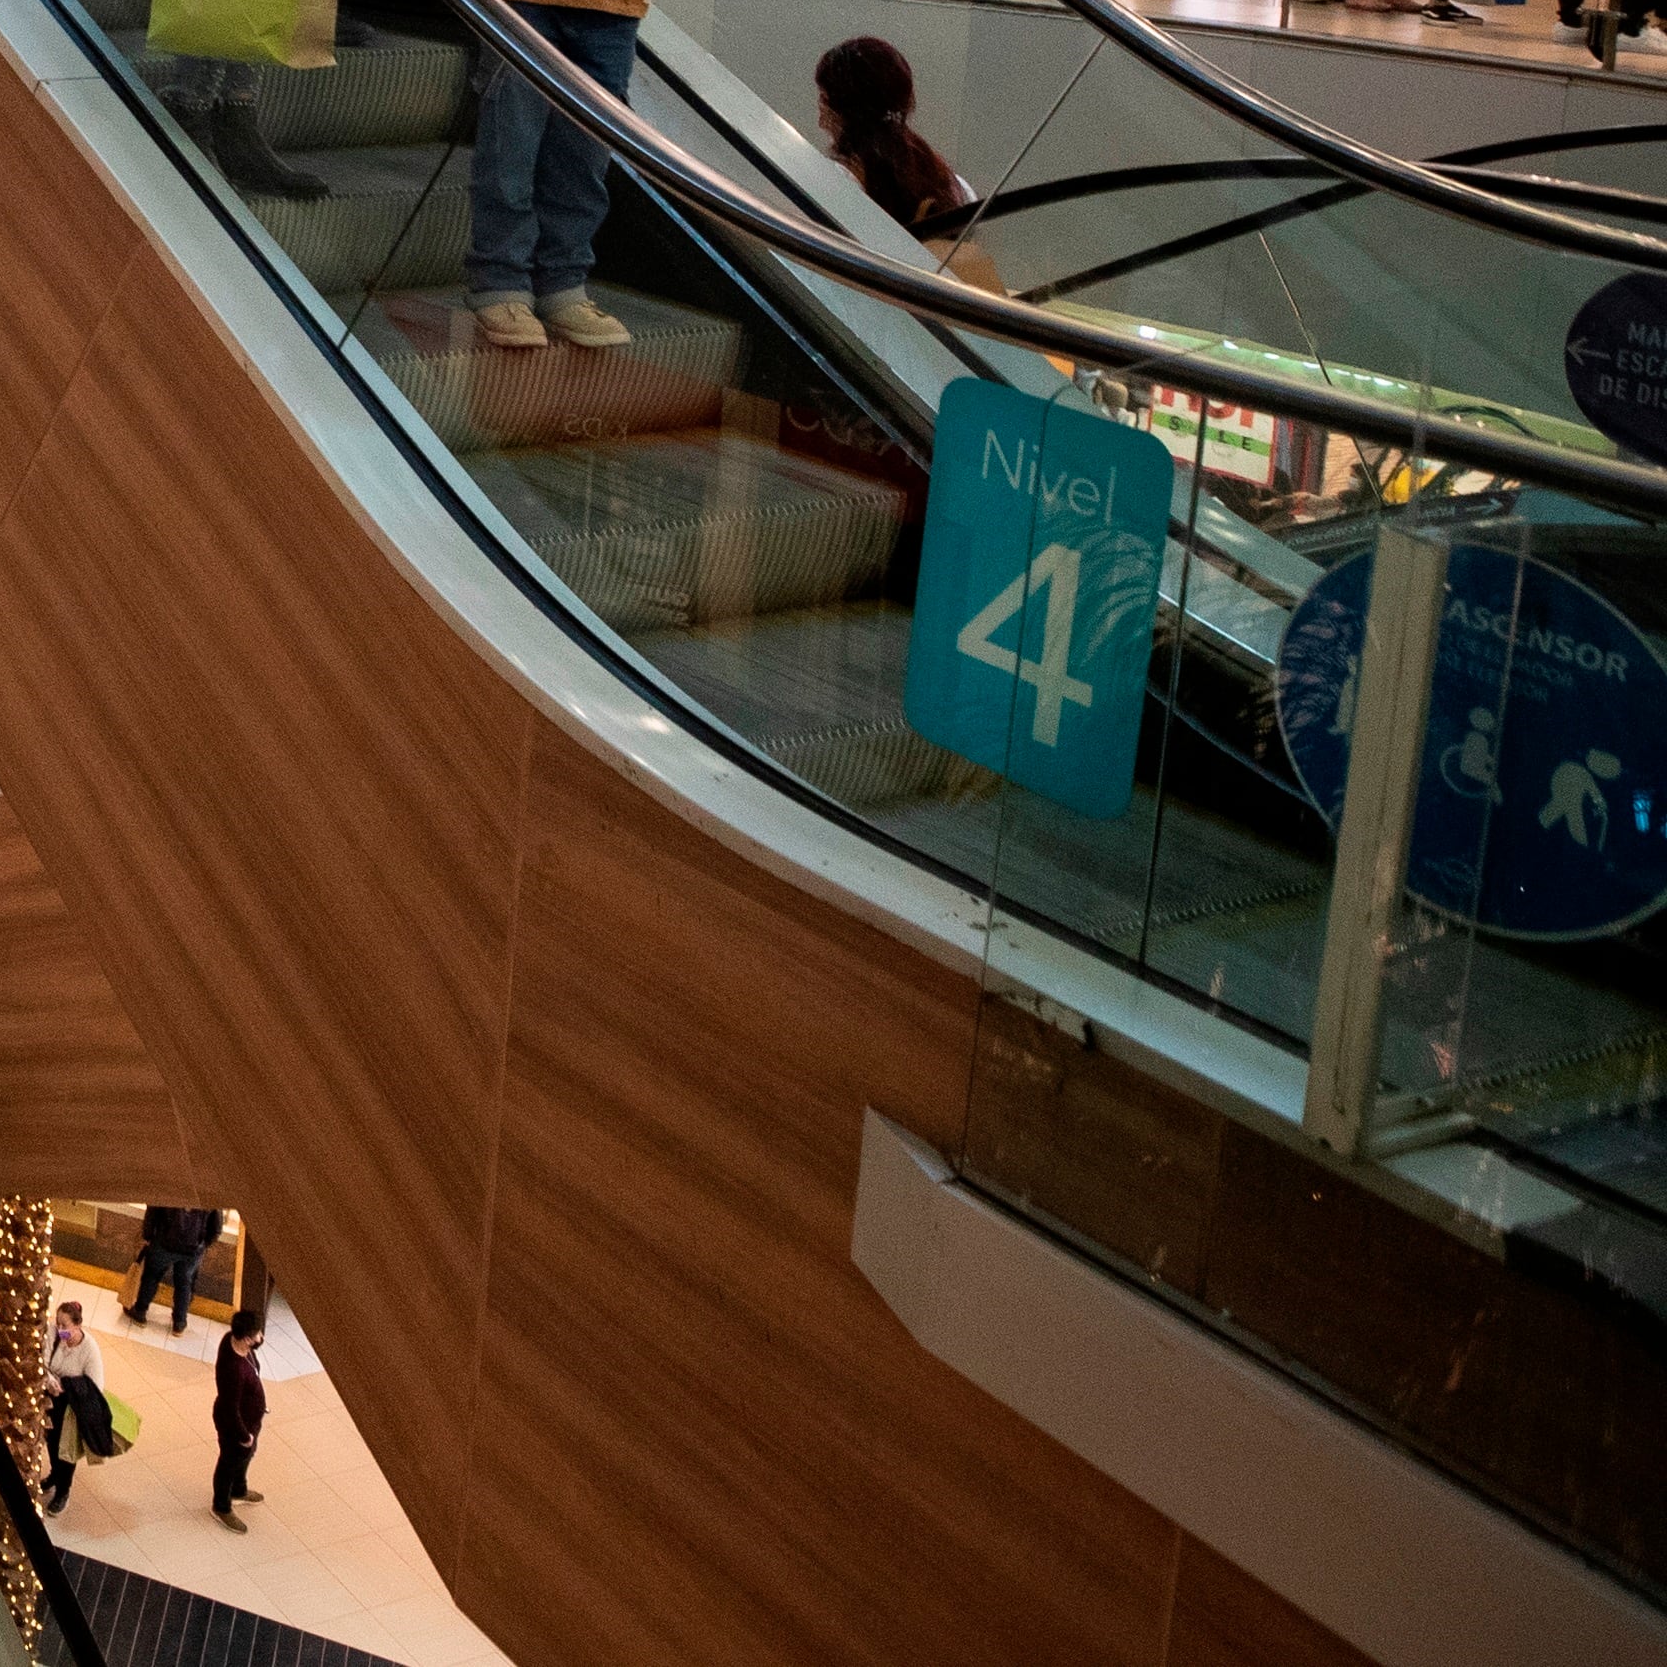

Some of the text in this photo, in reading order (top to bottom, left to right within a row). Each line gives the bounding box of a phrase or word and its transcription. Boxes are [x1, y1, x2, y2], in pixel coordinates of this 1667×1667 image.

[1628, 320, 1667, 350] MA
[1599, 373, 1627, 400] DE
[1169, 416, 1252, 452] SLE
[982, 429, 1115, 525] Nivel
[956, 541, 1093, 748] 4
[1446, 598, 1628, 682] ASCNSOR
